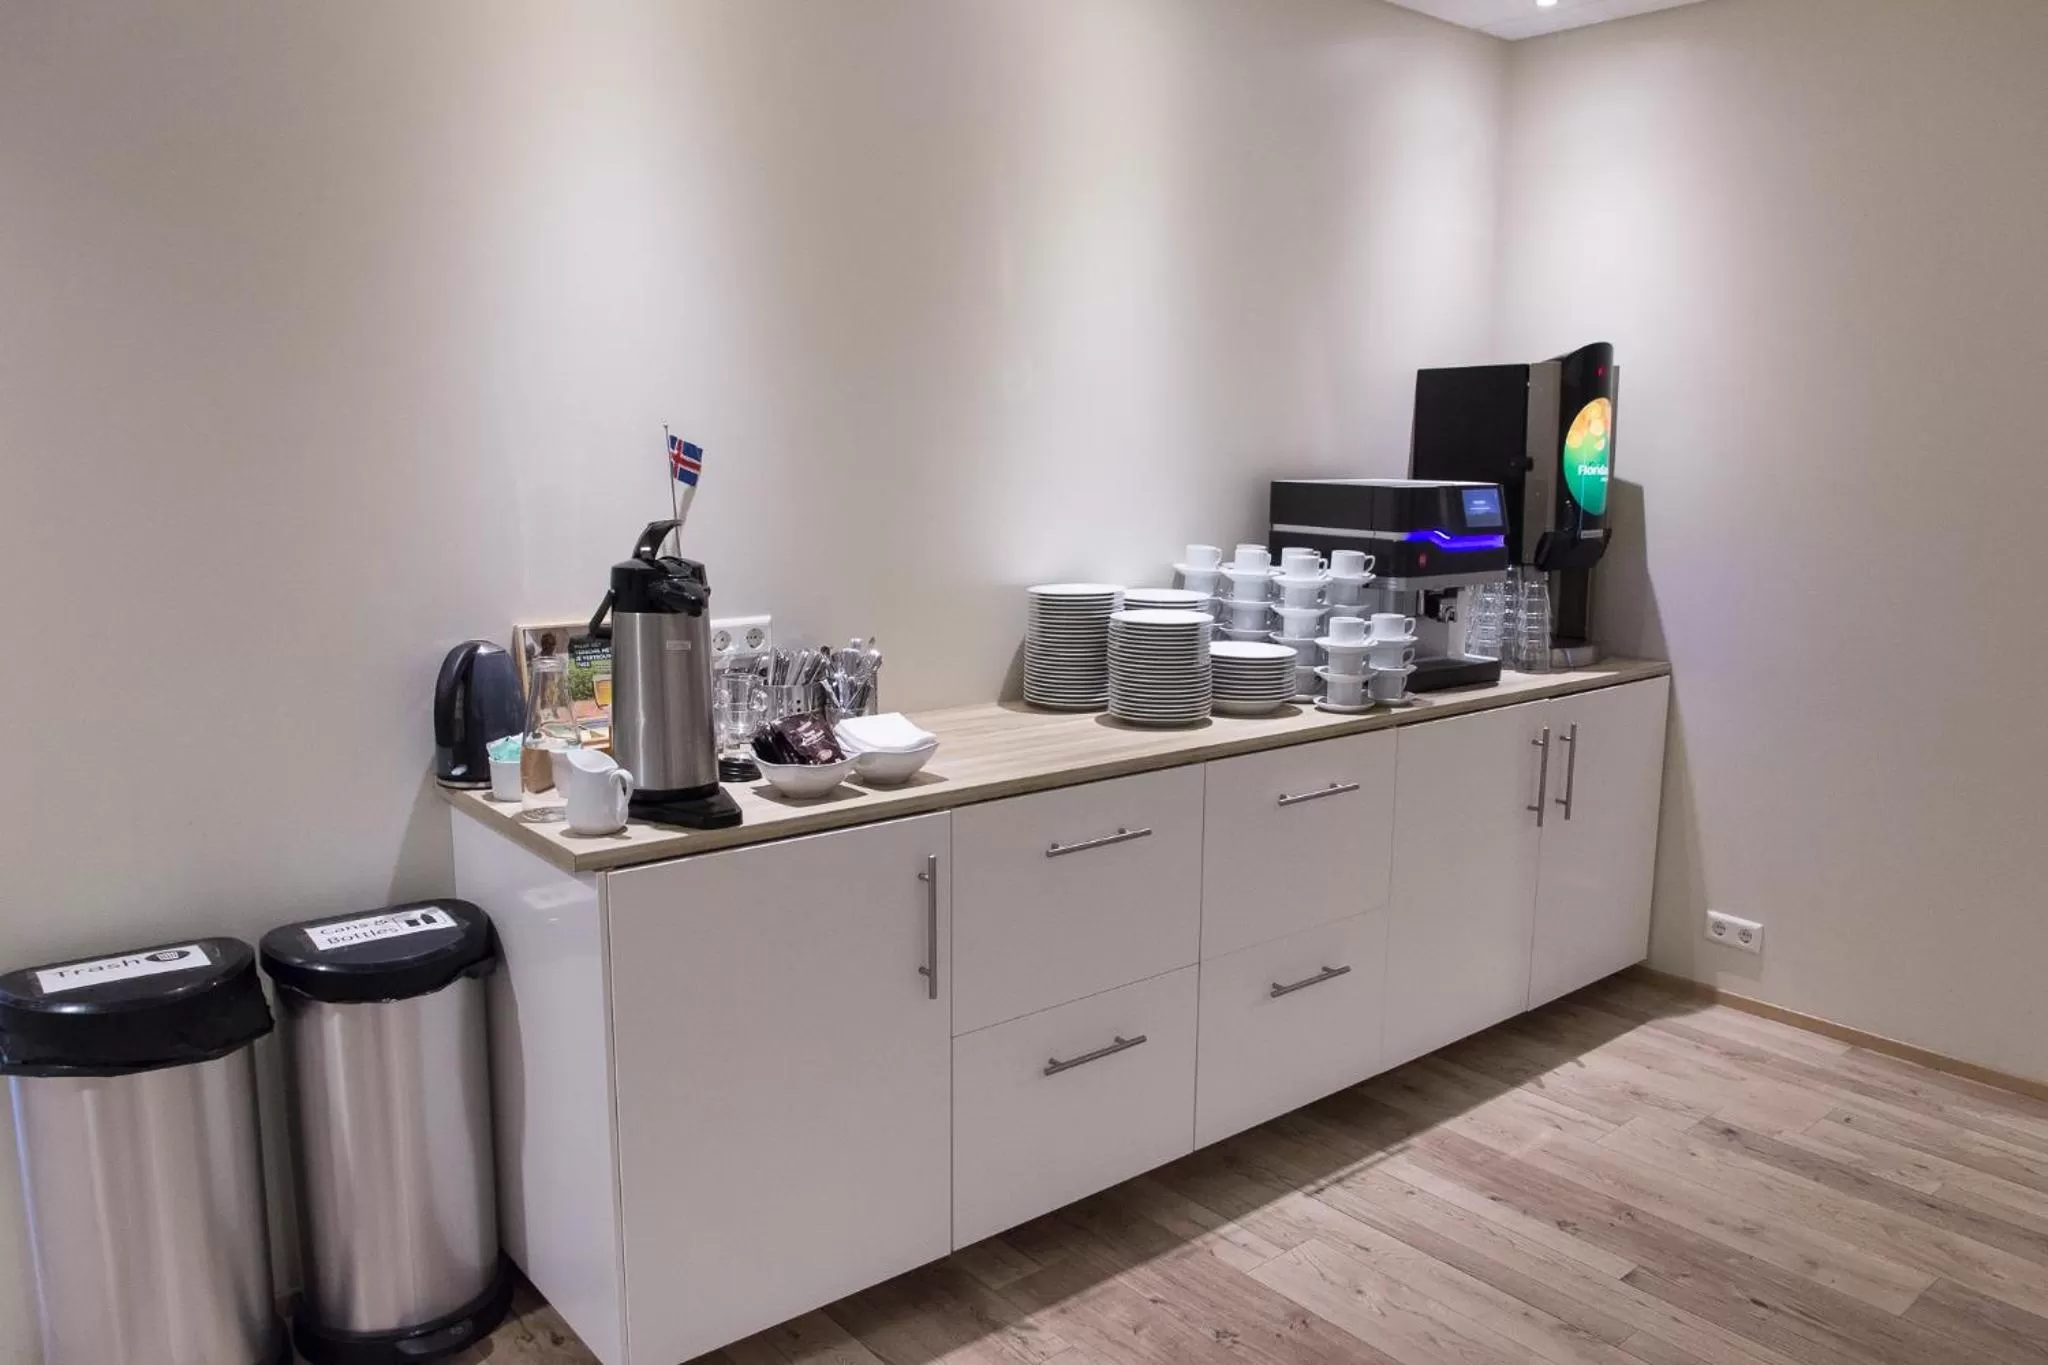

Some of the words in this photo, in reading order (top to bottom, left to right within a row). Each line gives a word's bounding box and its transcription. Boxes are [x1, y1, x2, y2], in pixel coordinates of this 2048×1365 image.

[320, 922, 369, 935] Cans
[327, 928, 398, 944] Bottles
[54, 958, 141, 978] Trash
